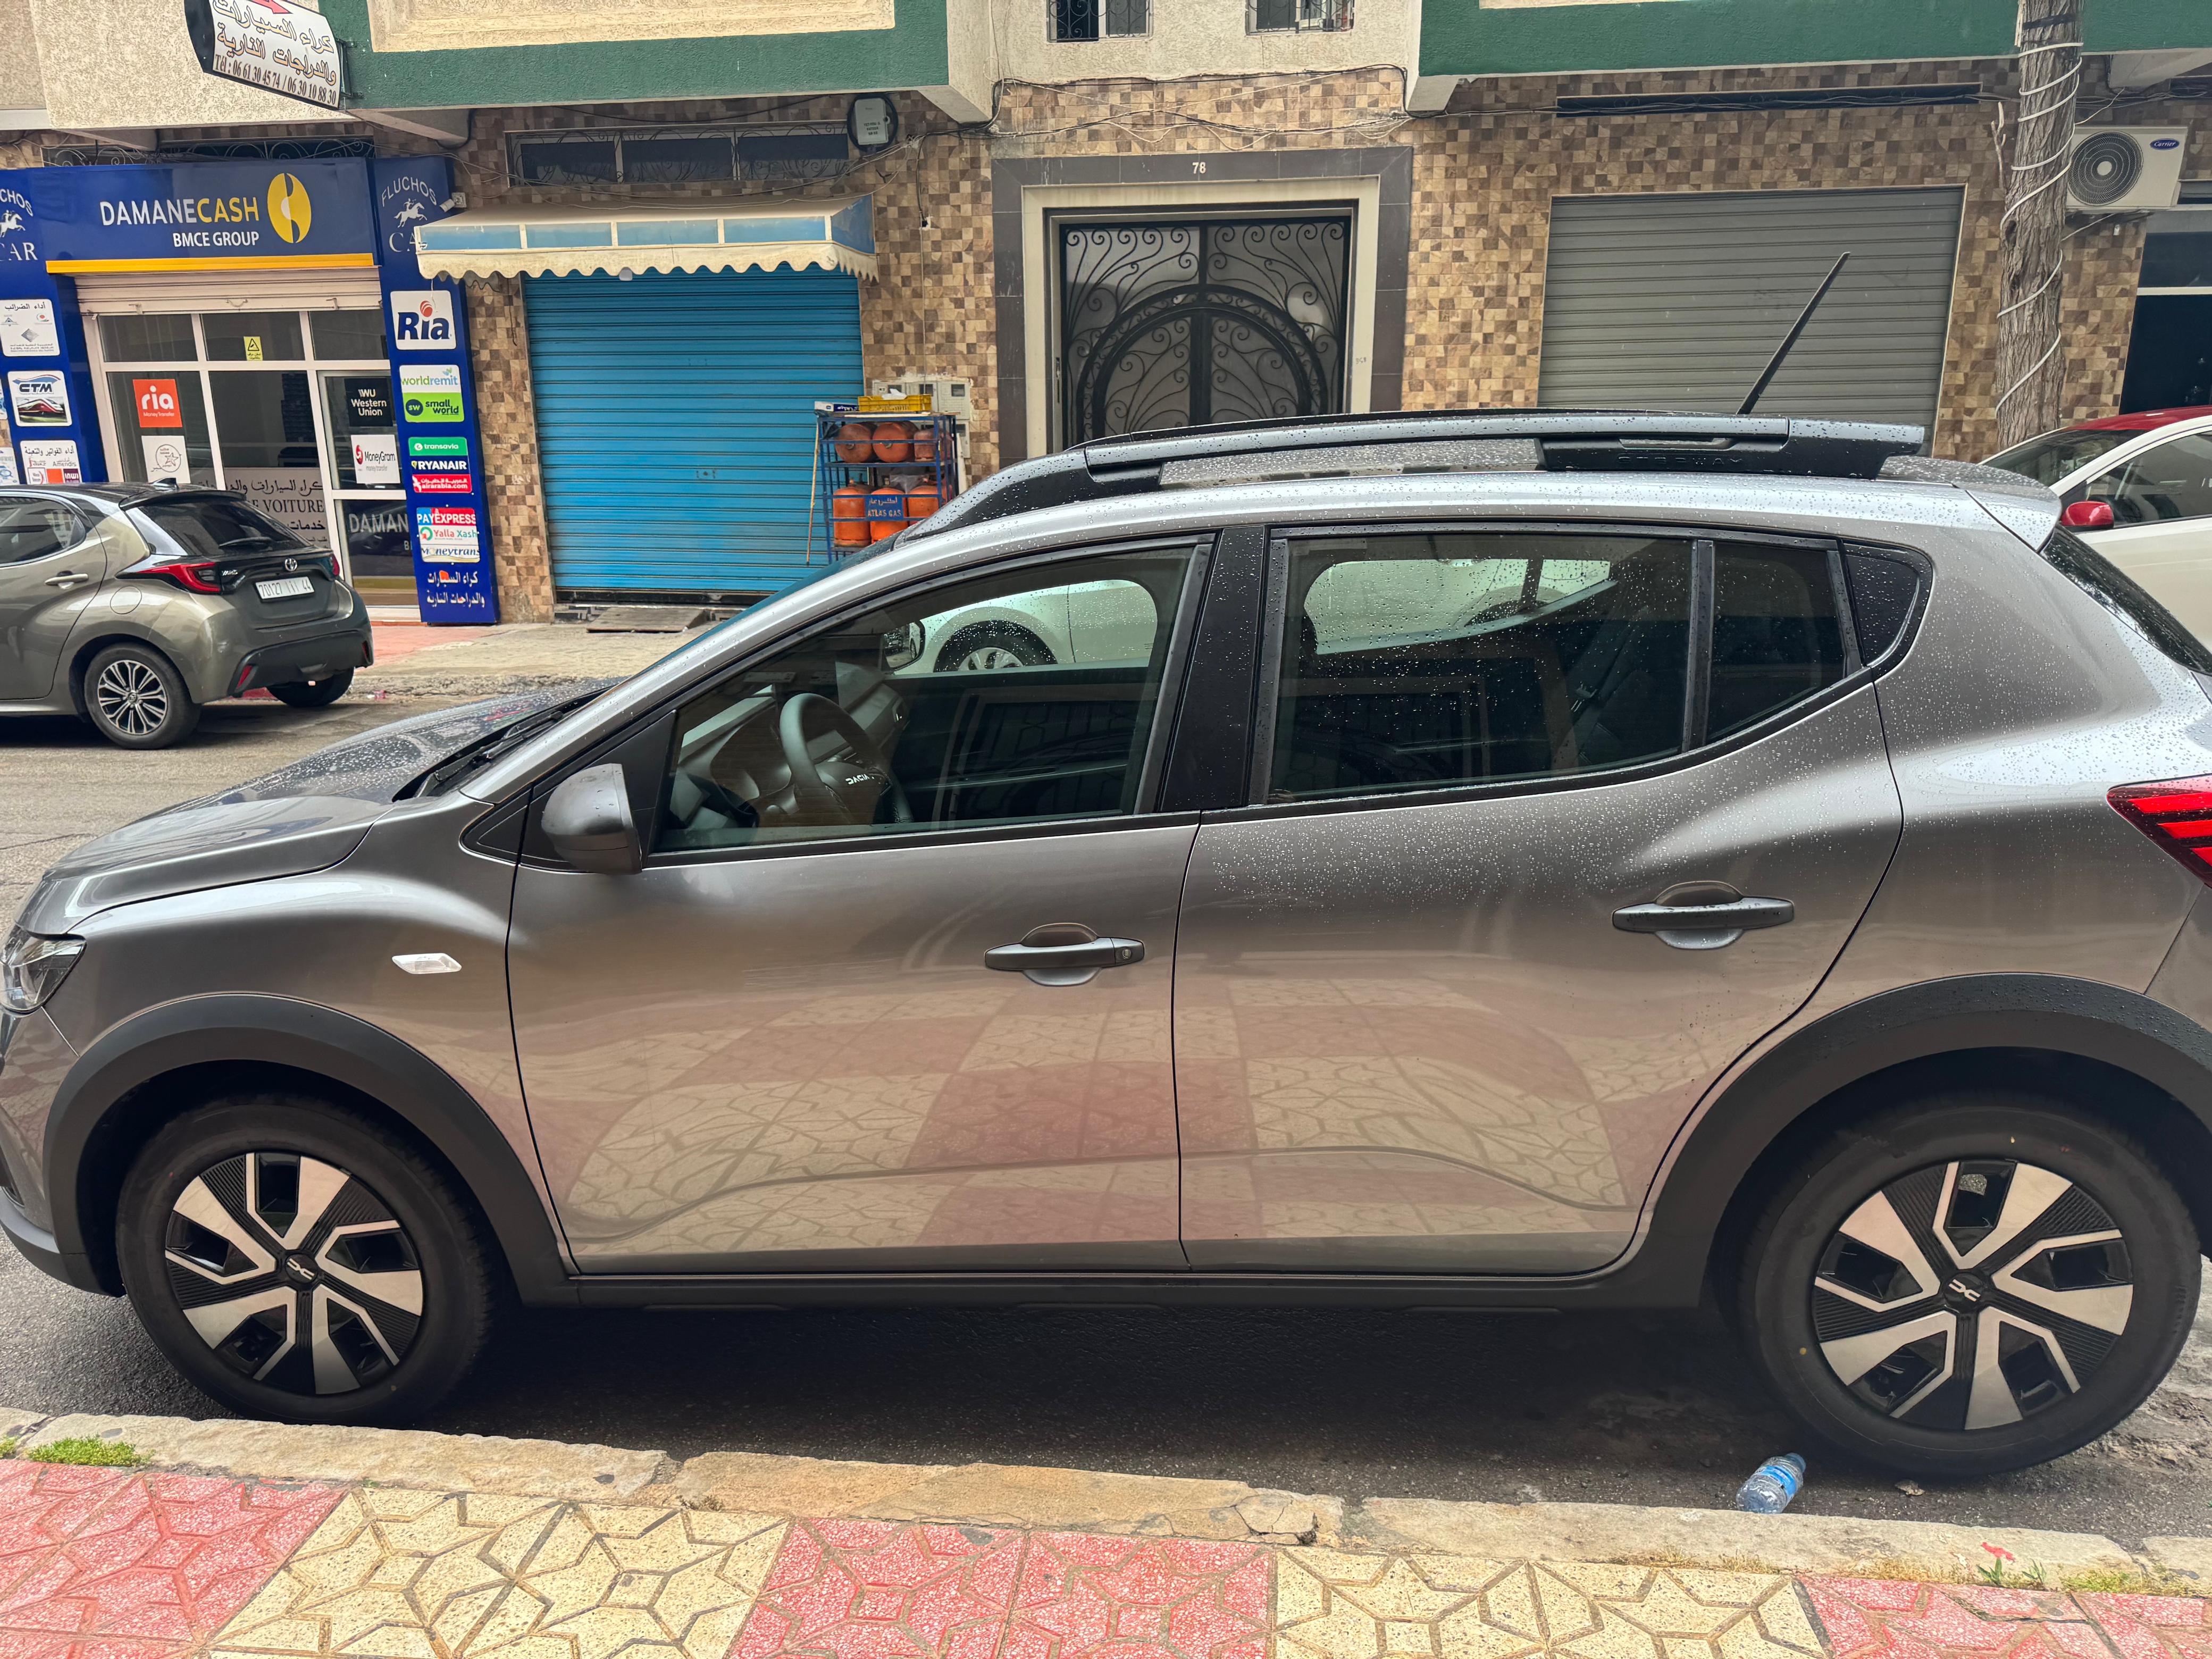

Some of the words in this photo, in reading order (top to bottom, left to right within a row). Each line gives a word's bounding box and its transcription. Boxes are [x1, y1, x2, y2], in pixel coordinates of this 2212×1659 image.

[213, 0, 297, 41] السيارات
[217, 22, 266, 59] النارية
[299, 28, 334, 54] كراء
[273, 48, 337, 86] والدراجات
[233, 58, 242, 76] 06
[242, 62, 252, 78] 61
[252, 66, 261, 81] 30
[288, 78, 297, 91] 06
[298, 80, 307, 96] 30
[309, 83, 317, 99] 10
[319, 87, 326, 101] 88
[328, 90, 337, 105] 30
[1192, 162, 1206, 174] 78
[382, 177, 437, 207] FLUCHOS
[99, 197, 259, 225] DAMANECASH
[173, 232, 211, 247] BMCE
[213, 231, 259, 246] GROUP
[0, 242, 38, 261] AR
[398, 301, 450, 340] Ria
[19, 383, 52, 392] CTM
[402, 375, 458, 386] worldremit
[141, 385, 174, 410] ria
[358, 389, 376, 398] WU
[351, 399, 387, 407] Western
[358, 408, 383, 416] Union
[365, 451, 396, 464] MoneyGram
[418, 460, 467, 470] RYANAIR
[252, 479, 295, 494] السيارات
[299, 480, 323, 496] كراء
[263, 499, 324, 513] VOITURE
[433, 529, 455, 538] Yalla
[457, 529, 477, 538] Xash
[463, 571, 478, 587] كراء
[258, 582, 283, 597] 70127
